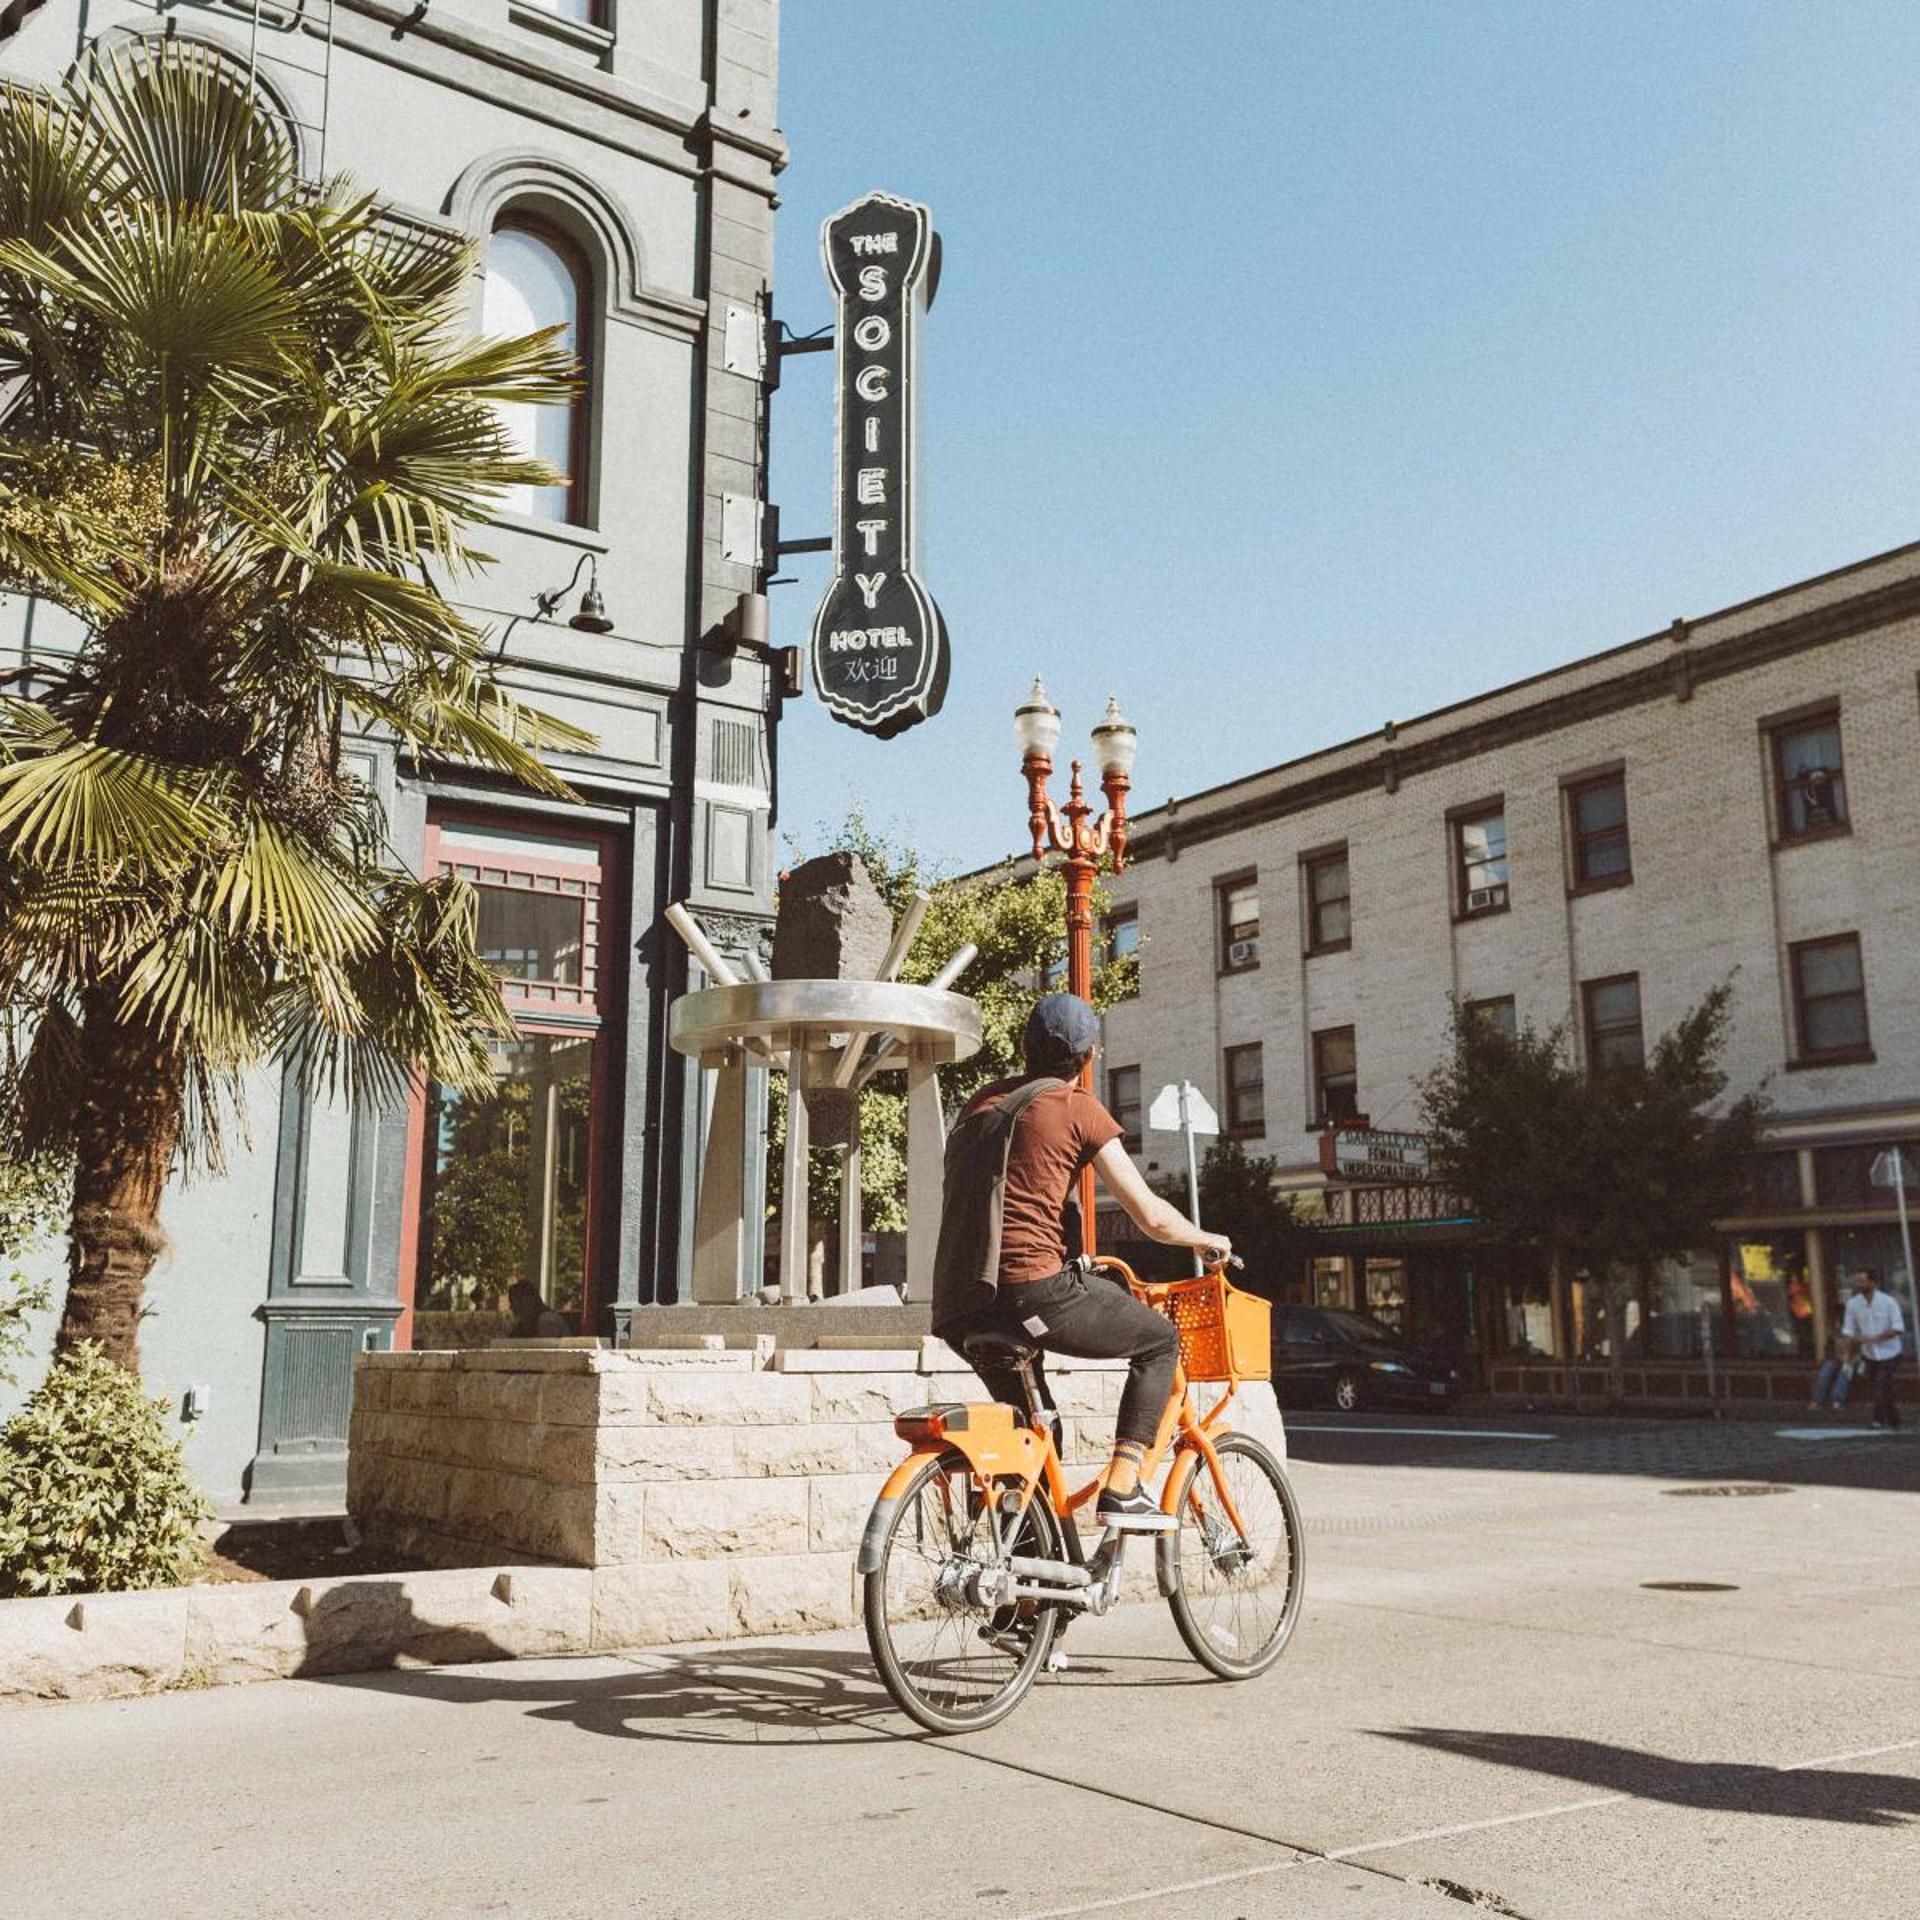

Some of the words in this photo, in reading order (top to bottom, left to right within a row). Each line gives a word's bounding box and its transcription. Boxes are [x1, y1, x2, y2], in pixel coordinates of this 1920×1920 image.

[850, 232, 899, 256] THE
[853, 264, 891, 609] SOCIETY
[830, 626, 913, 652] HOTEL
[844, 654, 898, 681] 欢迎
